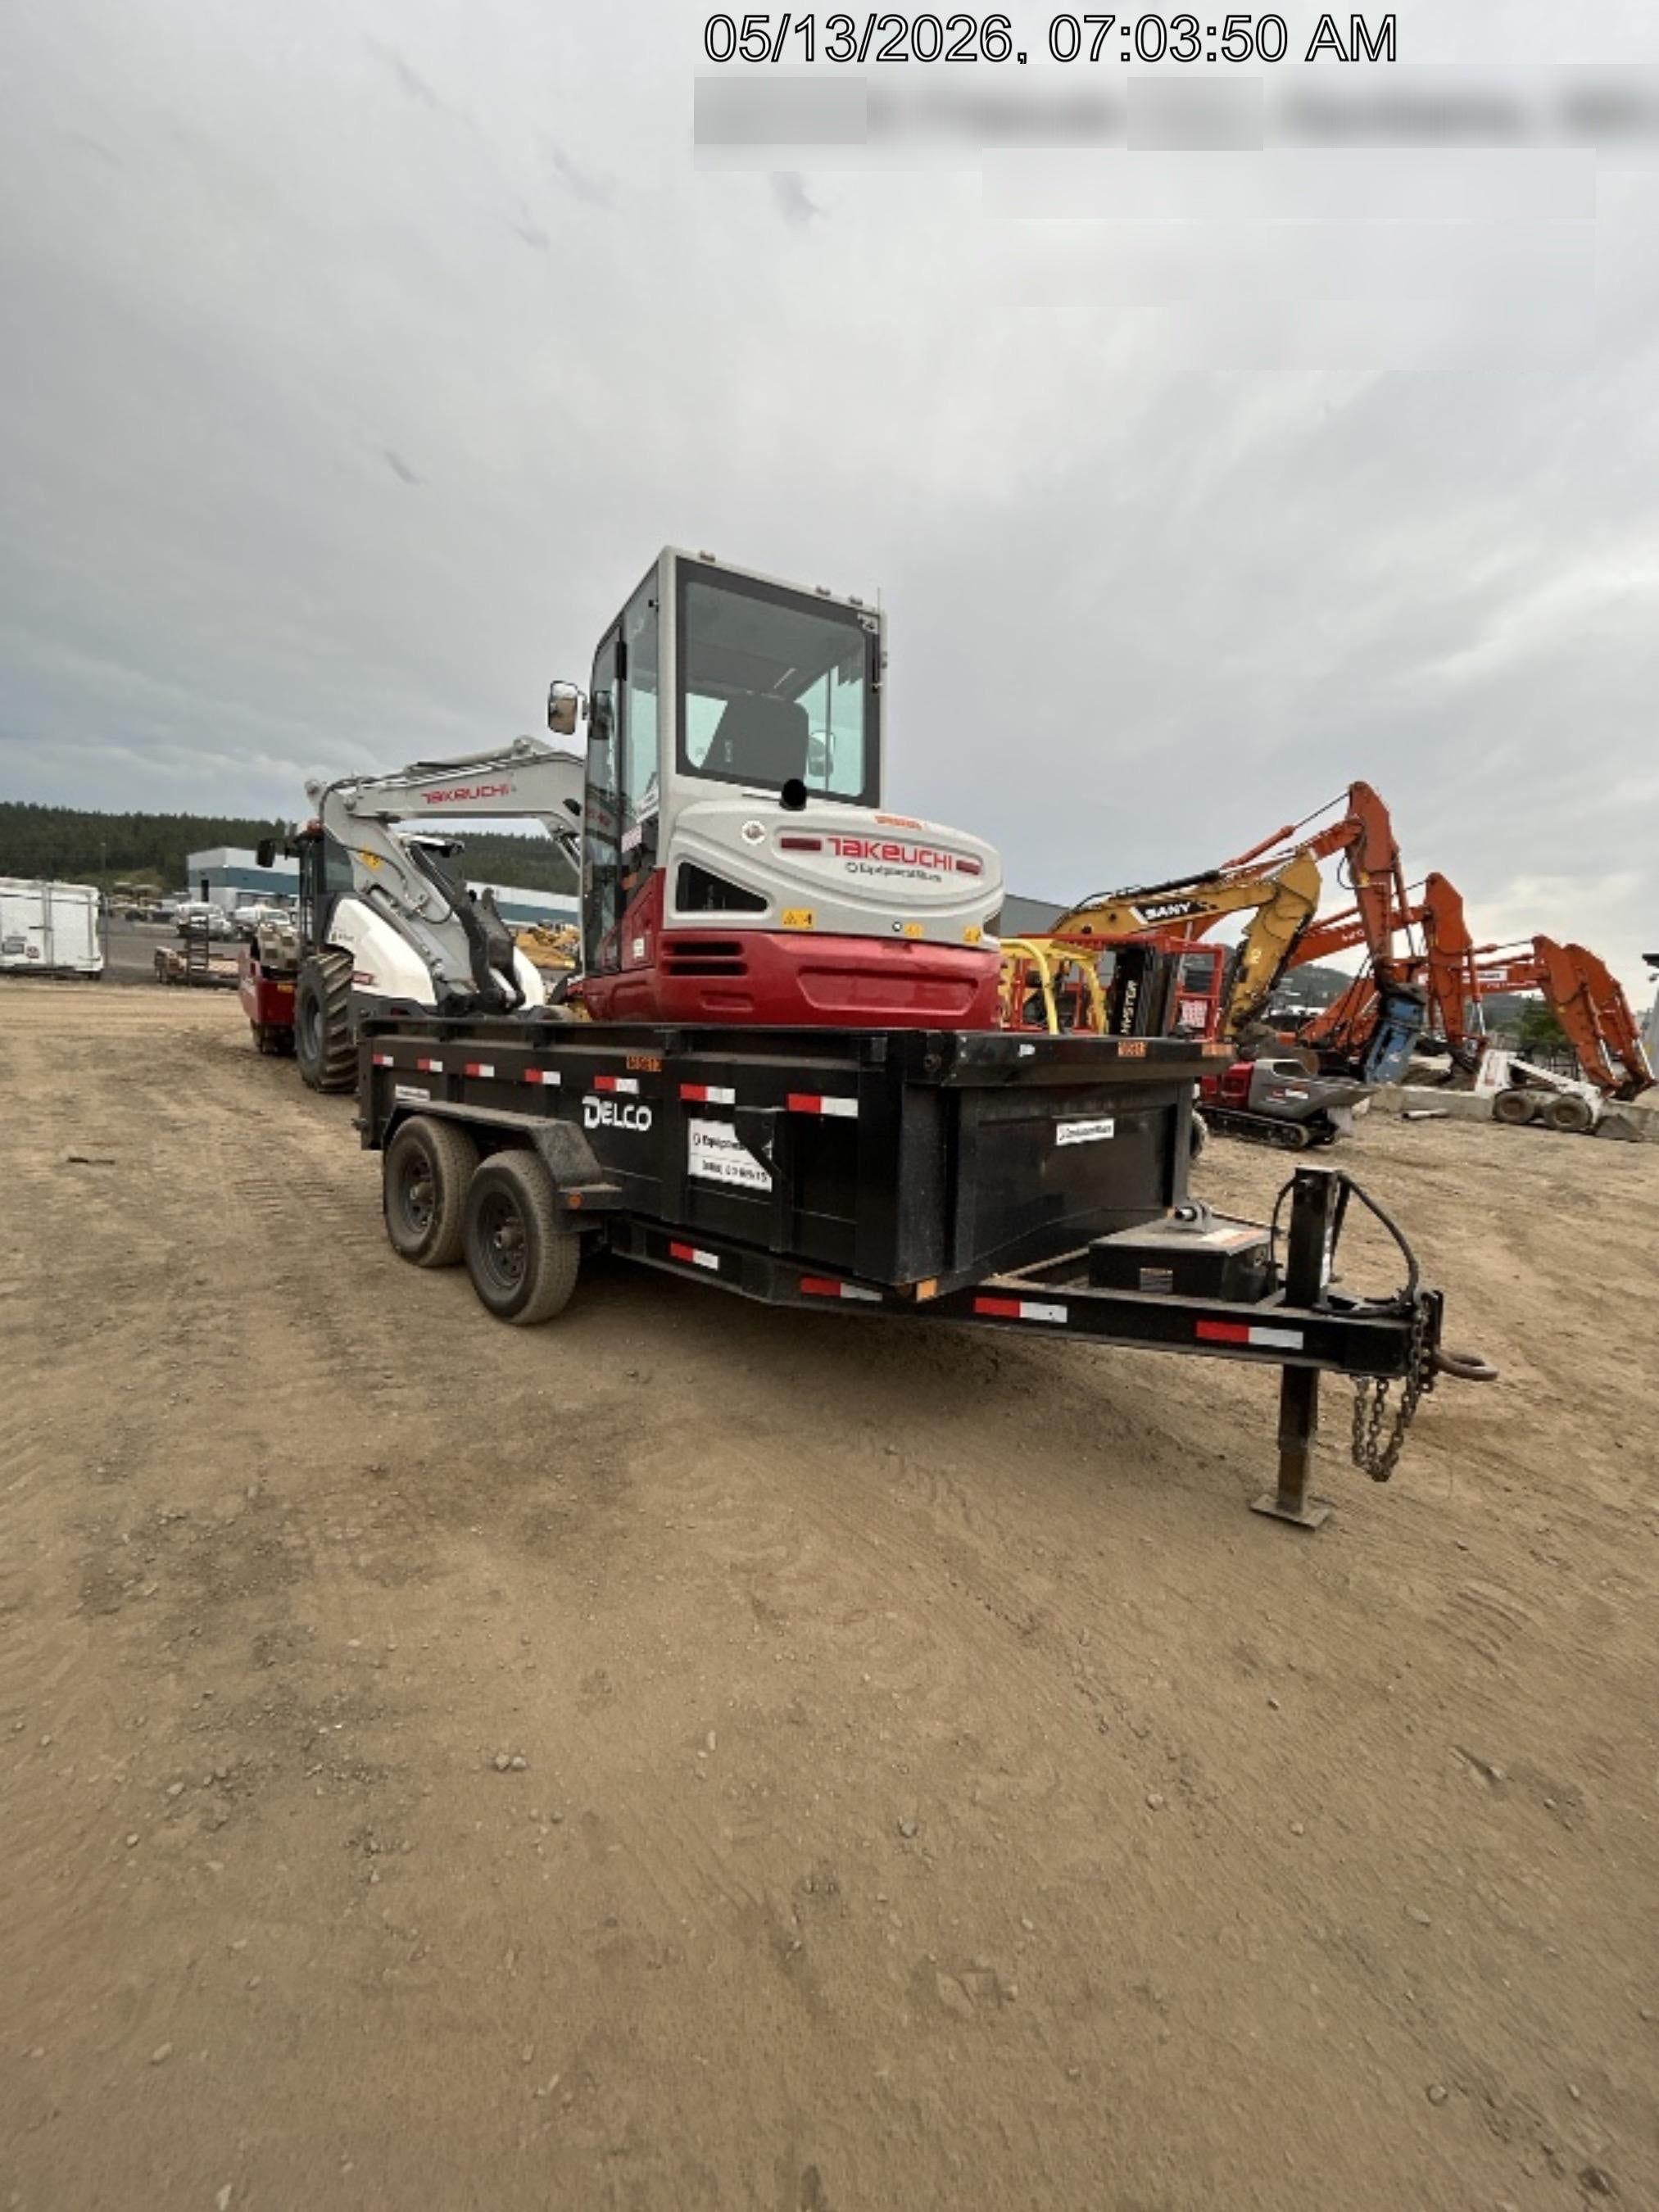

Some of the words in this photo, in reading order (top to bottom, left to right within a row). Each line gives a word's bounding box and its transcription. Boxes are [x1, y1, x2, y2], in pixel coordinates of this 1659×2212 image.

[420, 784, 510, 804] TAKEUCHI
[827, 837, 953, 871] TAKEUCHI
[1145, 902, 1191, 920] SANY
[582, 1095, 652, 1131] DELCO
